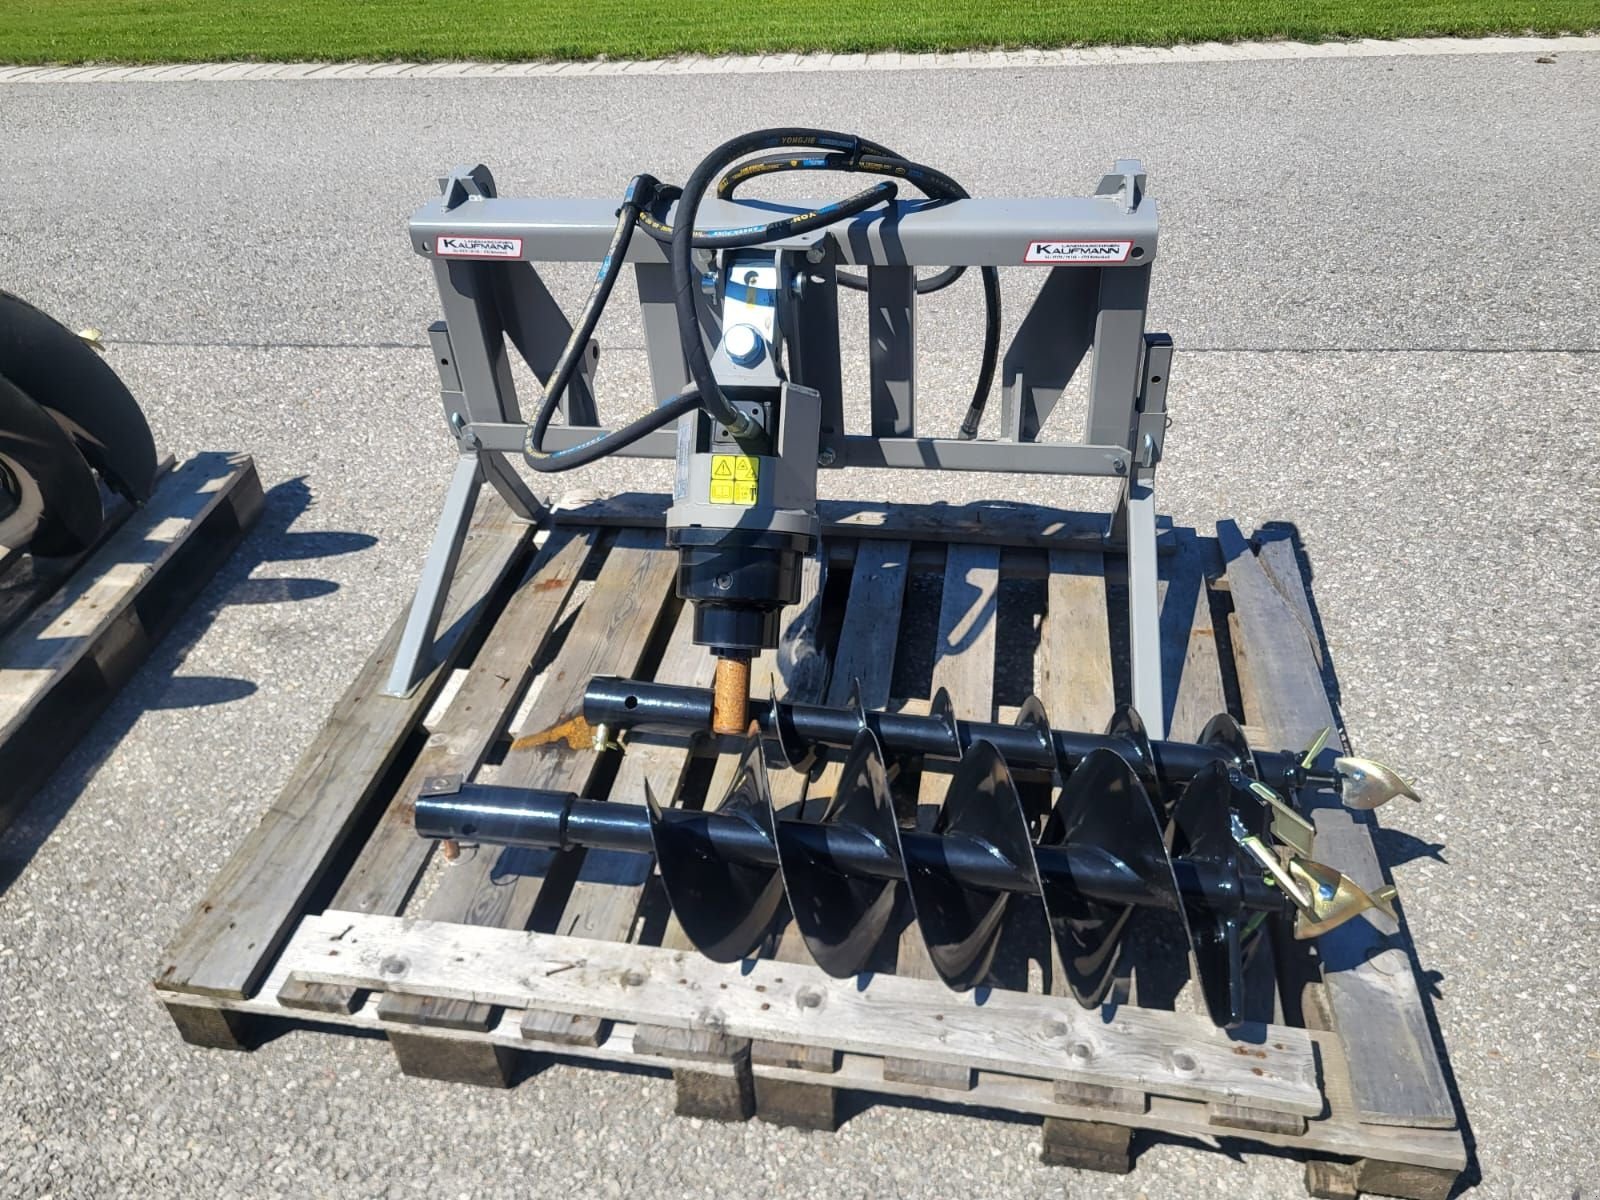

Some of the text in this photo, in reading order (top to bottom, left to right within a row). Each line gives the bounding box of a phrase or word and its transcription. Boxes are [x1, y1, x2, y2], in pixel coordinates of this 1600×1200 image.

[781, 135, 816, 145] YONGJIE
[443, 239, 514, 250] KAUFMANN
[1036, 244, 1120, 254] KAUFMANN
